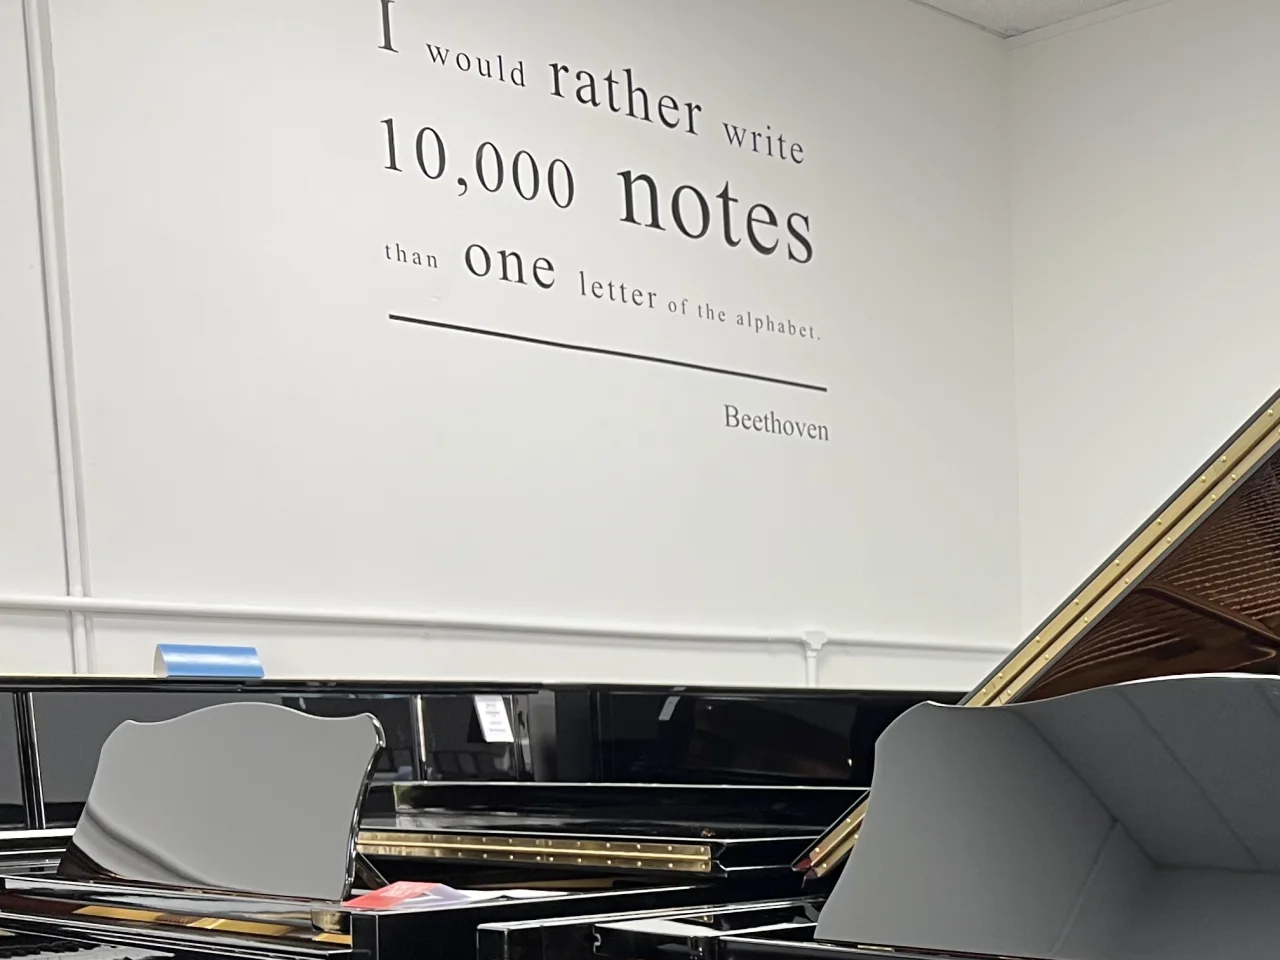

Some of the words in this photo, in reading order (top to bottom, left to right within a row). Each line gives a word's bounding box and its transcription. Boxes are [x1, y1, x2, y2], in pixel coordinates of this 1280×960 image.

[378, 0, 399, 53] I
[425, 43, 526, 87] would
[548, 62, 702, 136] rather
[722, 121, 804, 164] write
[380, 117, 575, 208] 10,000
[616, 170, 813, 264] notes
[384, 242, 438, 269] than
[464, 242, 556, 289] one
[579, 270, 657, 309] letter
[668, 299, 689, 315] of
[697, 303, 727, 322] the
[736, 311, 821, 341] alphabet.
[724, 404, 829, 441] Beethoven
